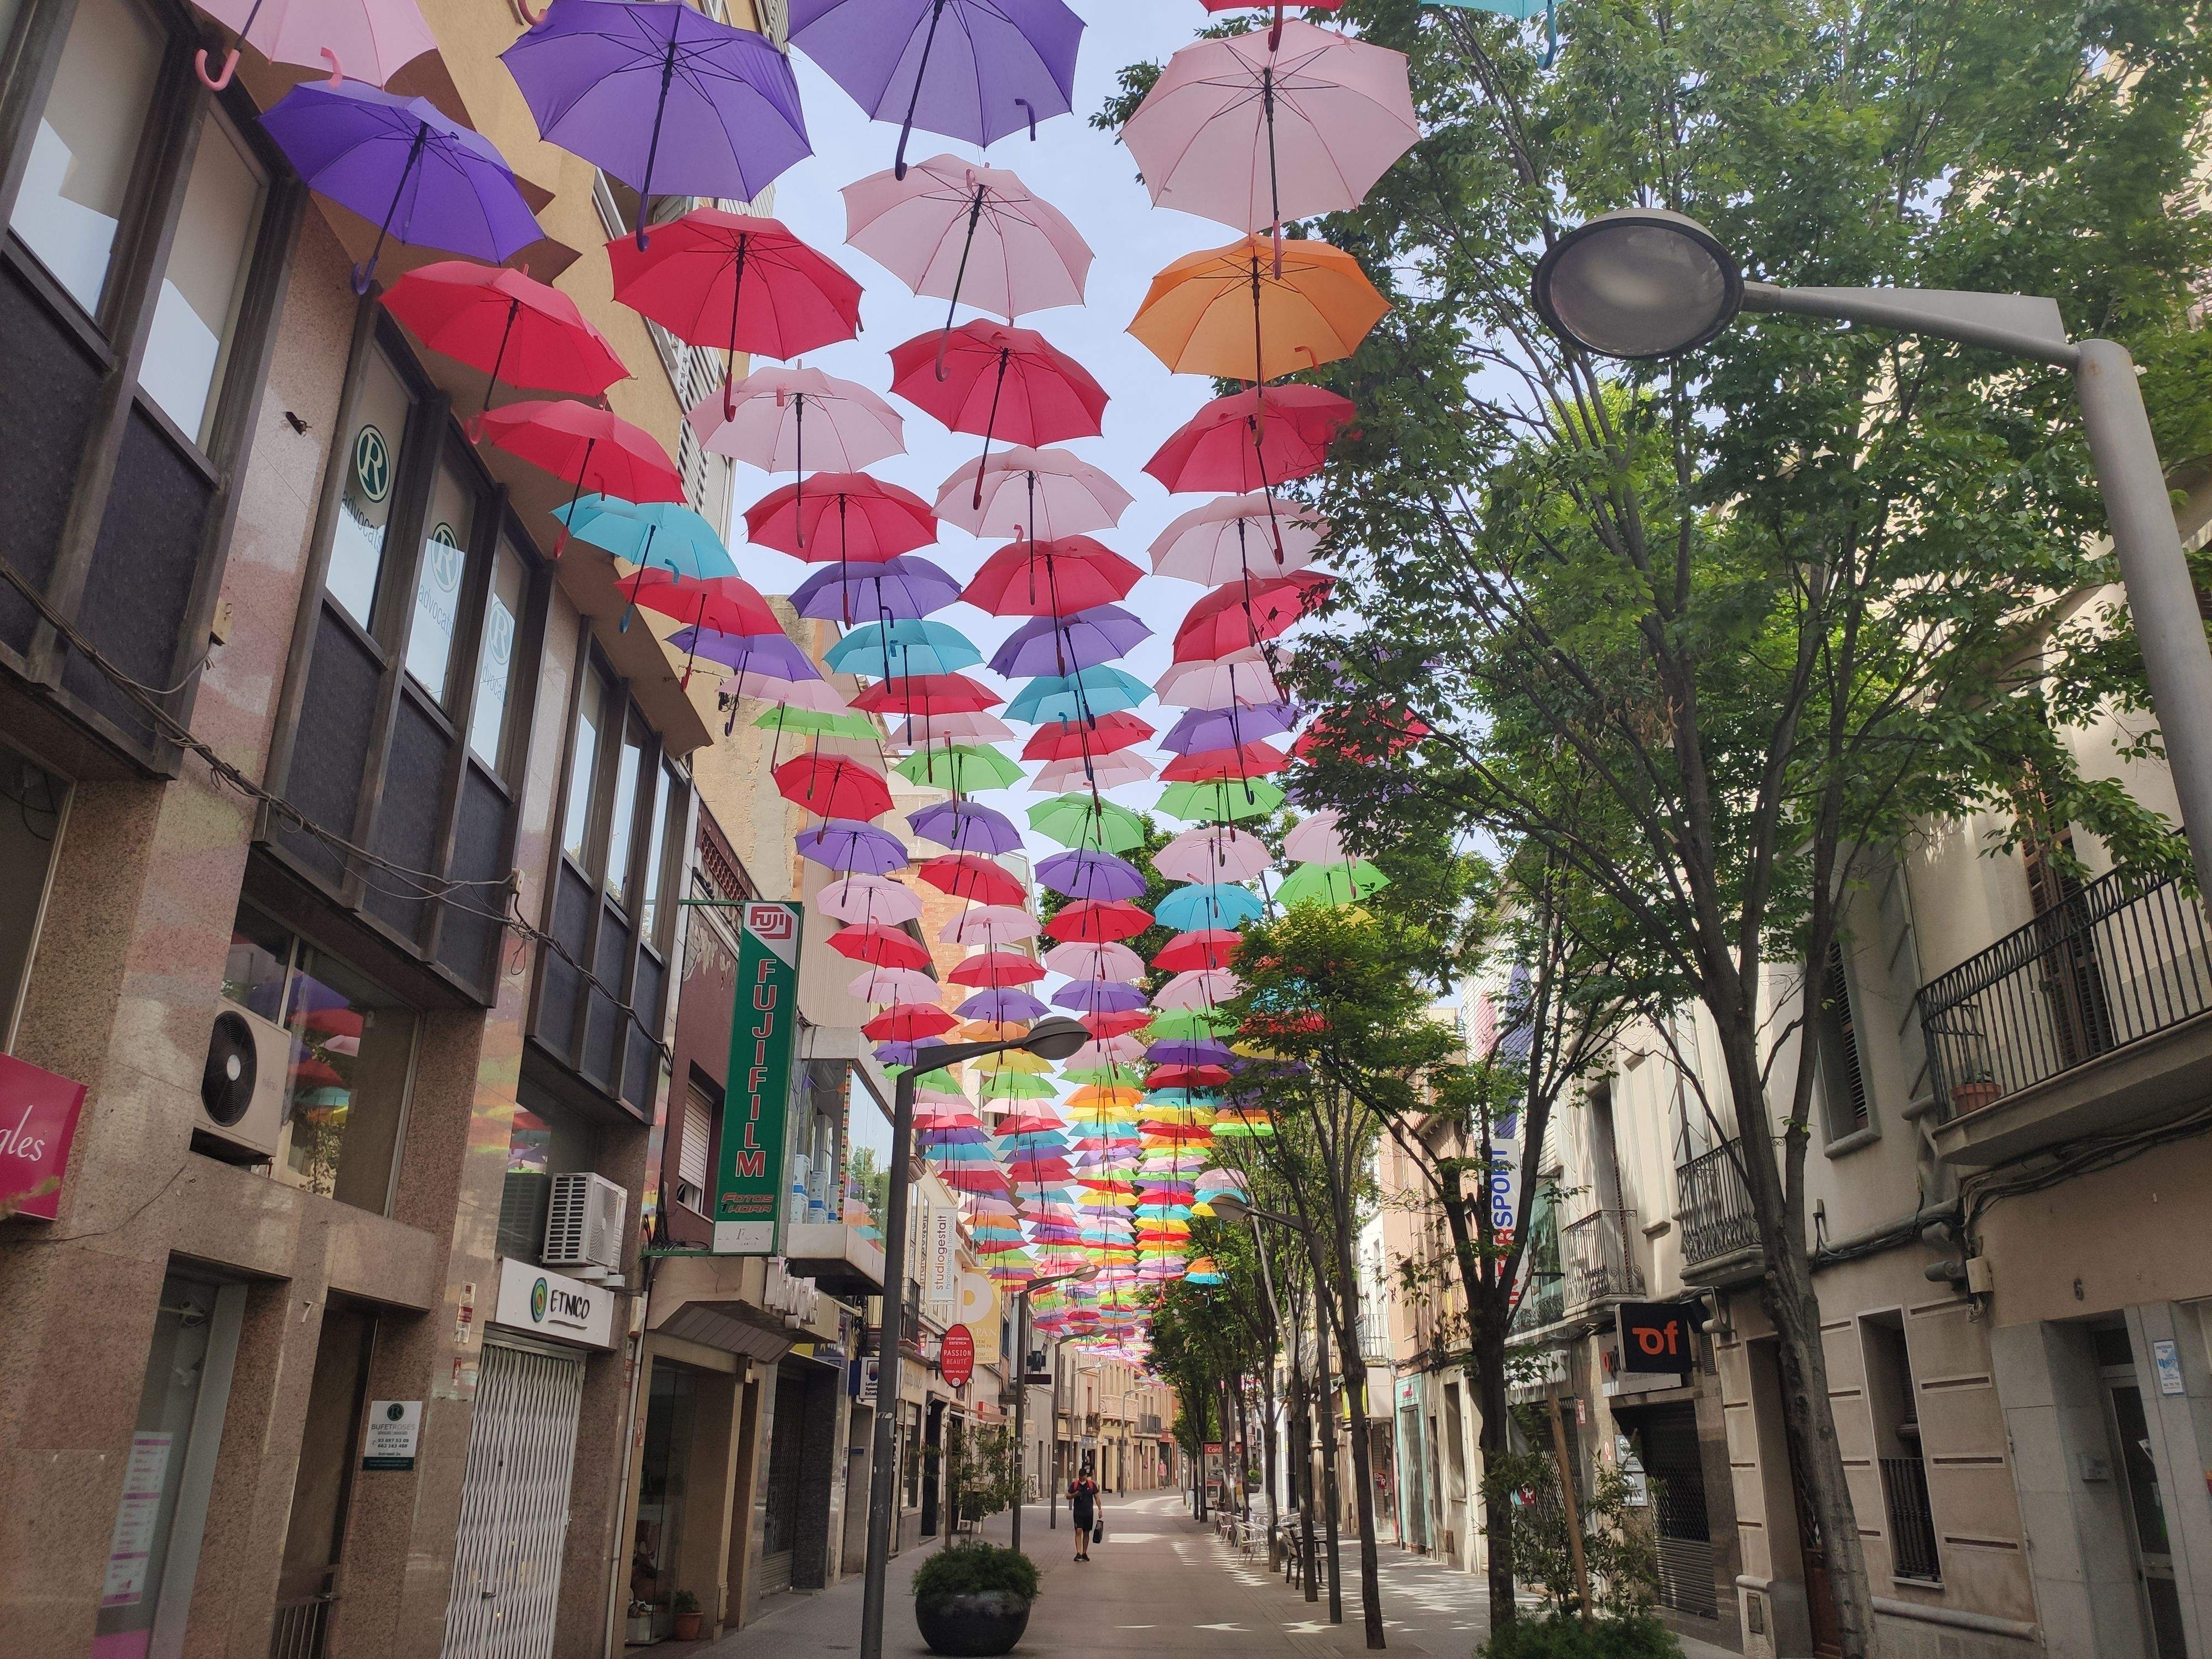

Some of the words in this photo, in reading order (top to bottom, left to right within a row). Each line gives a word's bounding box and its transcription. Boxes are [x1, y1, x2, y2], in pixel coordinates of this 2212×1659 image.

[342, 490, 385, 554] advocats
[418, 584, 453, 638] advocats
[483, 664, 507, 707] dvocats
[750, 906, 789, 935] FUJI
[735, 958, 776, 1177] FUJIFILM
[721, 1202, 729, 1213] 1
[935, 1215, 948, 1290] studiogestalt
[550, 1290, 590, 1319] ETNICO
[2073, 1278, 2084, 1301] 6
[302, 1301, 313, 1323] 7
